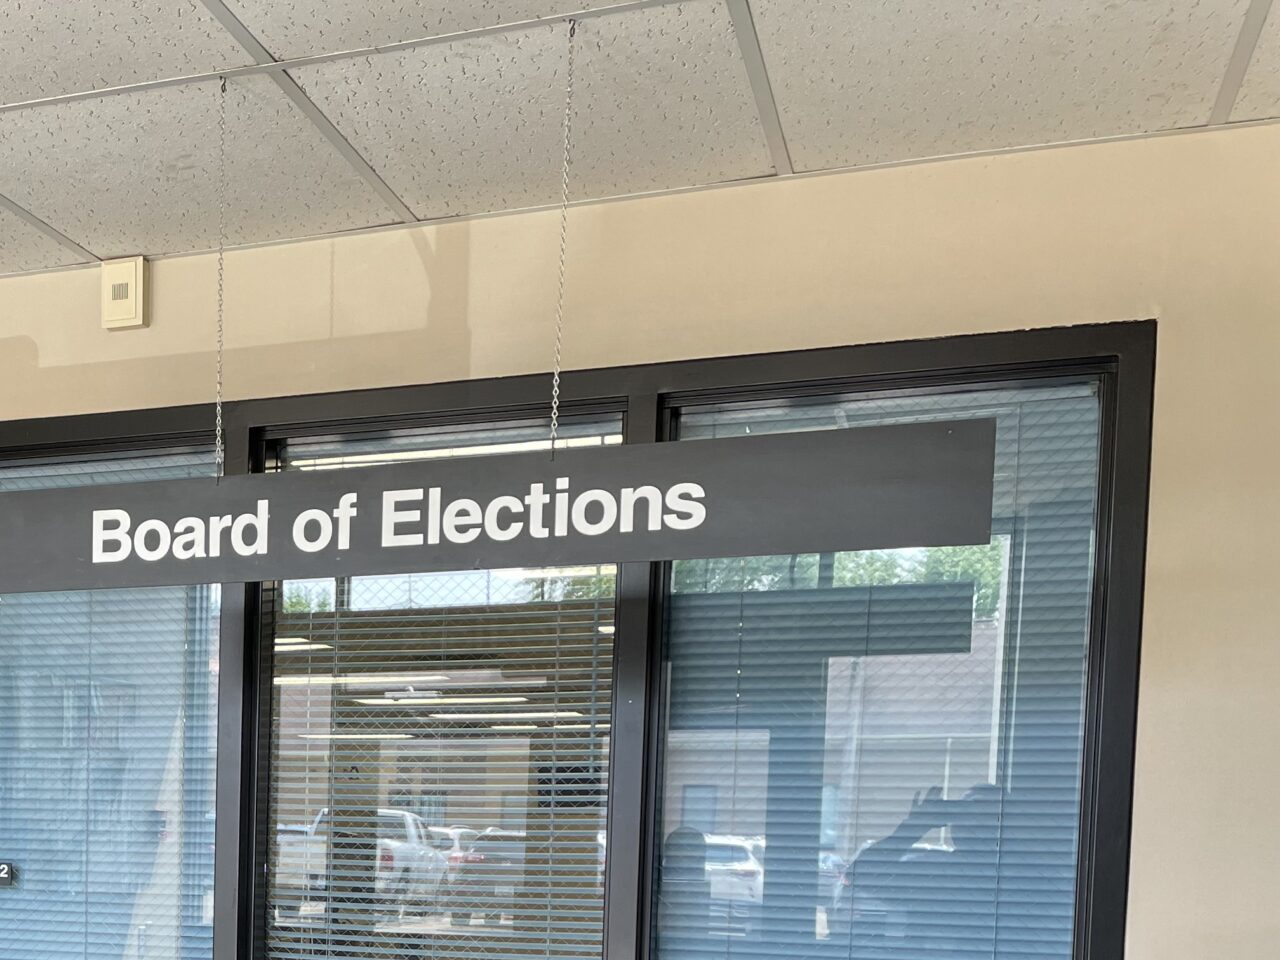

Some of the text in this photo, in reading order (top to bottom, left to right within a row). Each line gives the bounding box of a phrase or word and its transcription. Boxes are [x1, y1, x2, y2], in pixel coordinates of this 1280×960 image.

[92, 477, 706, 563] Board of Elections
